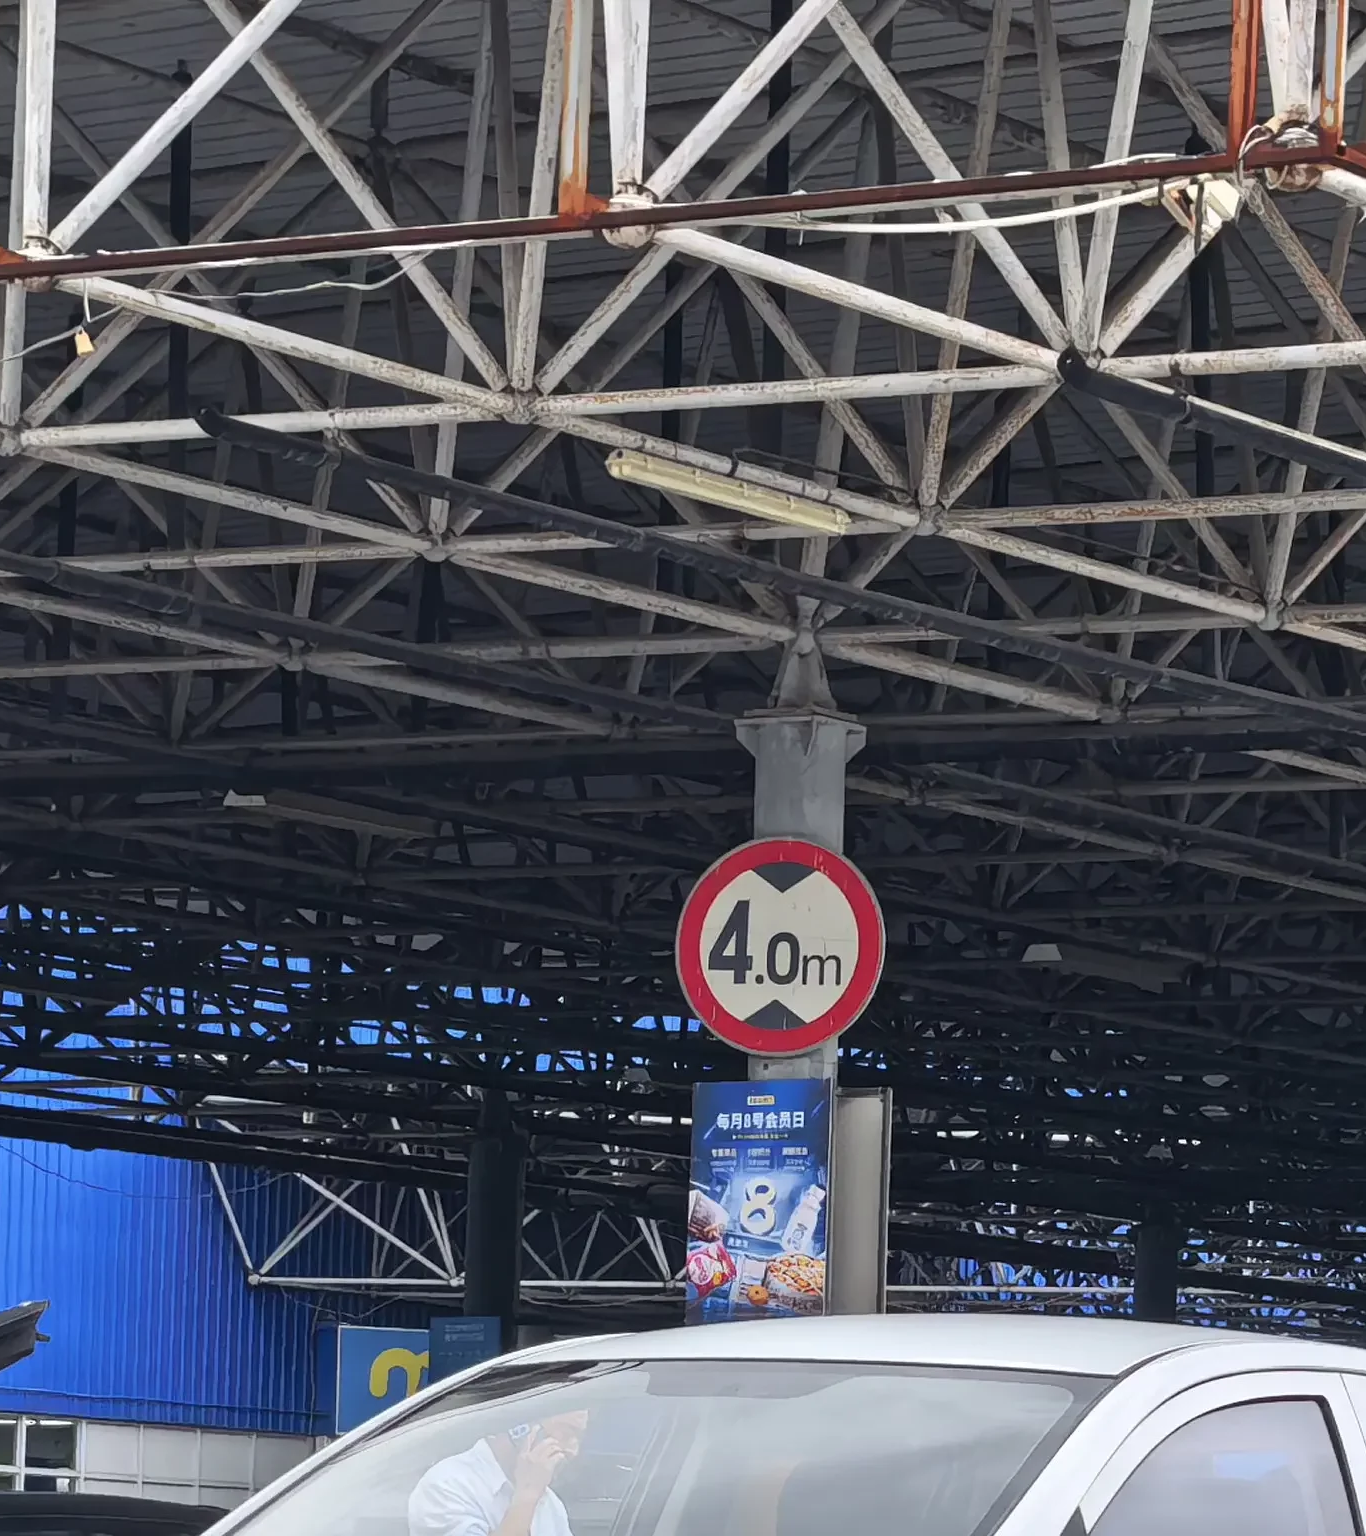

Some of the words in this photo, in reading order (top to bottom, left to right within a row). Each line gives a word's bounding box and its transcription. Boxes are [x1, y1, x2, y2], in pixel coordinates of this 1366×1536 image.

[707, 898, 842, 986] 4.0m
[716, 1111, 805, 1130] 每月8号会员日
